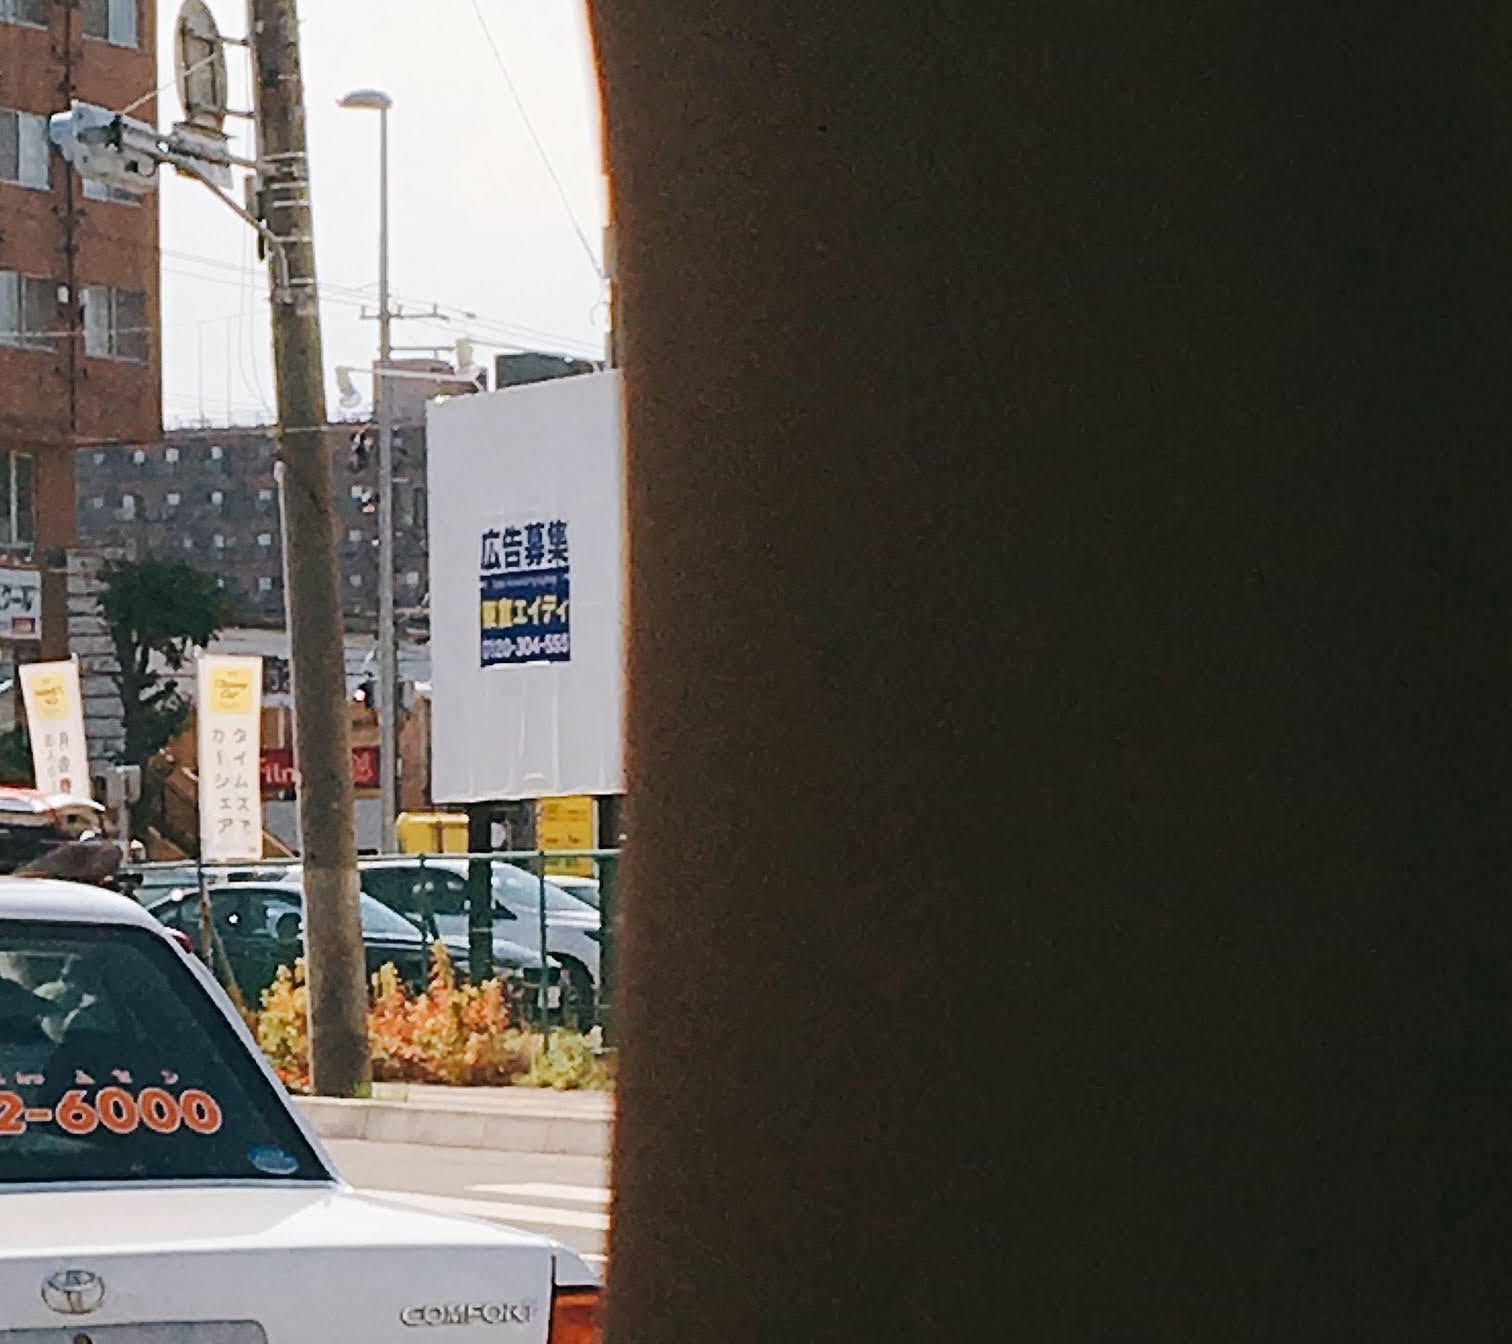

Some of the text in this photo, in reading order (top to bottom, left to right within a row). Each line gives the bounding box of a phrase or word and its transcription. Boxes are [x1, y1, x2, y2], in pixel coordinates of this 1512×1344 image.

[481, 520, 569, 569] 広告募集
[400, 1303, 535, 1326] COMFORT
